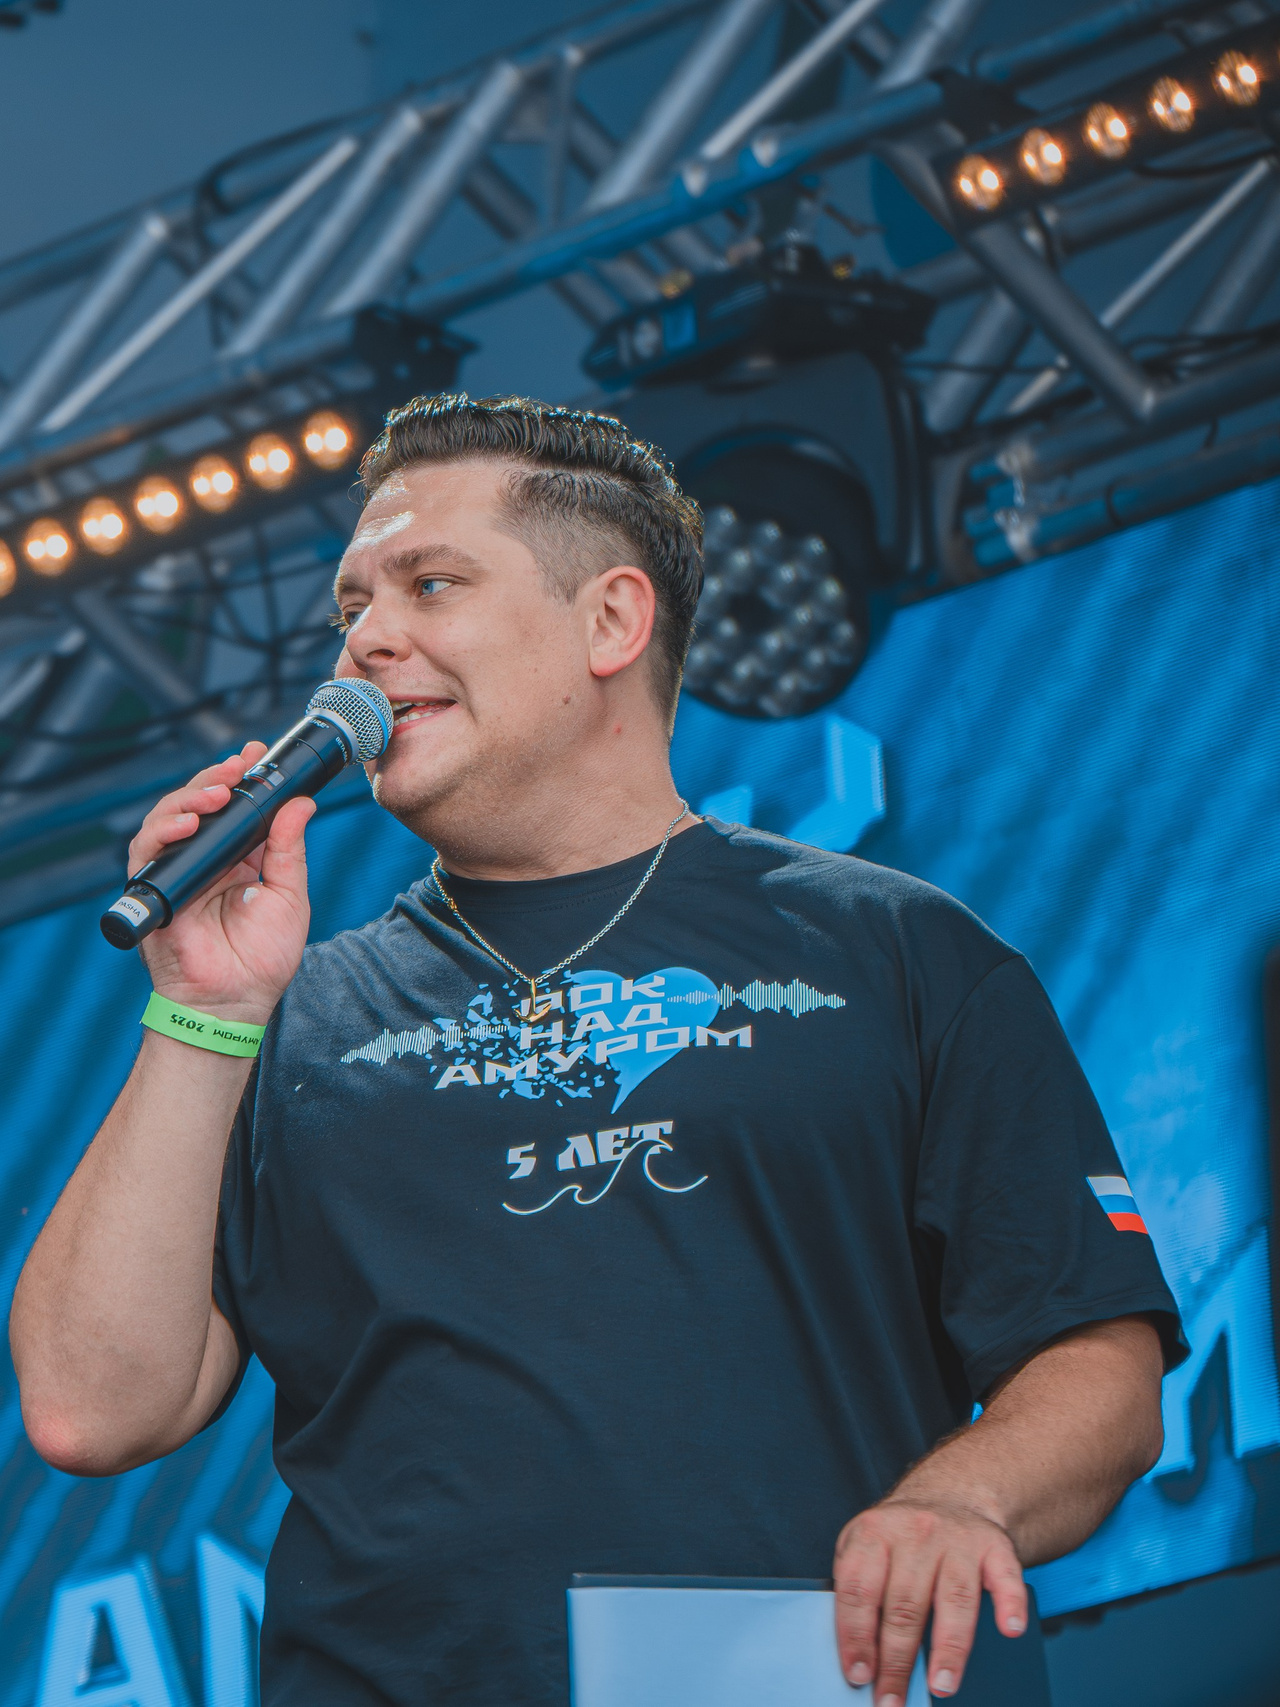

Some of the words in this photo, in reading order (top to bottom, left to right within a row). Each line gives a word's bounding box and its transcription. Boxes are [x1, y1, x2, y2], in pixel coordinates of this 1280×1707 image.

[117, 901, 141, 918] PASHA
[520, 975, 666, 1017] РОК
[170, 1013, 205, 1033] 2025
[520, 1003, 669, 1051] НАД
[434, 1025, 752, 1090] АМУРОМ
[507, 1142, 537, 1180] 5
[556, 1120, 673, 1172] ЛЕТ
